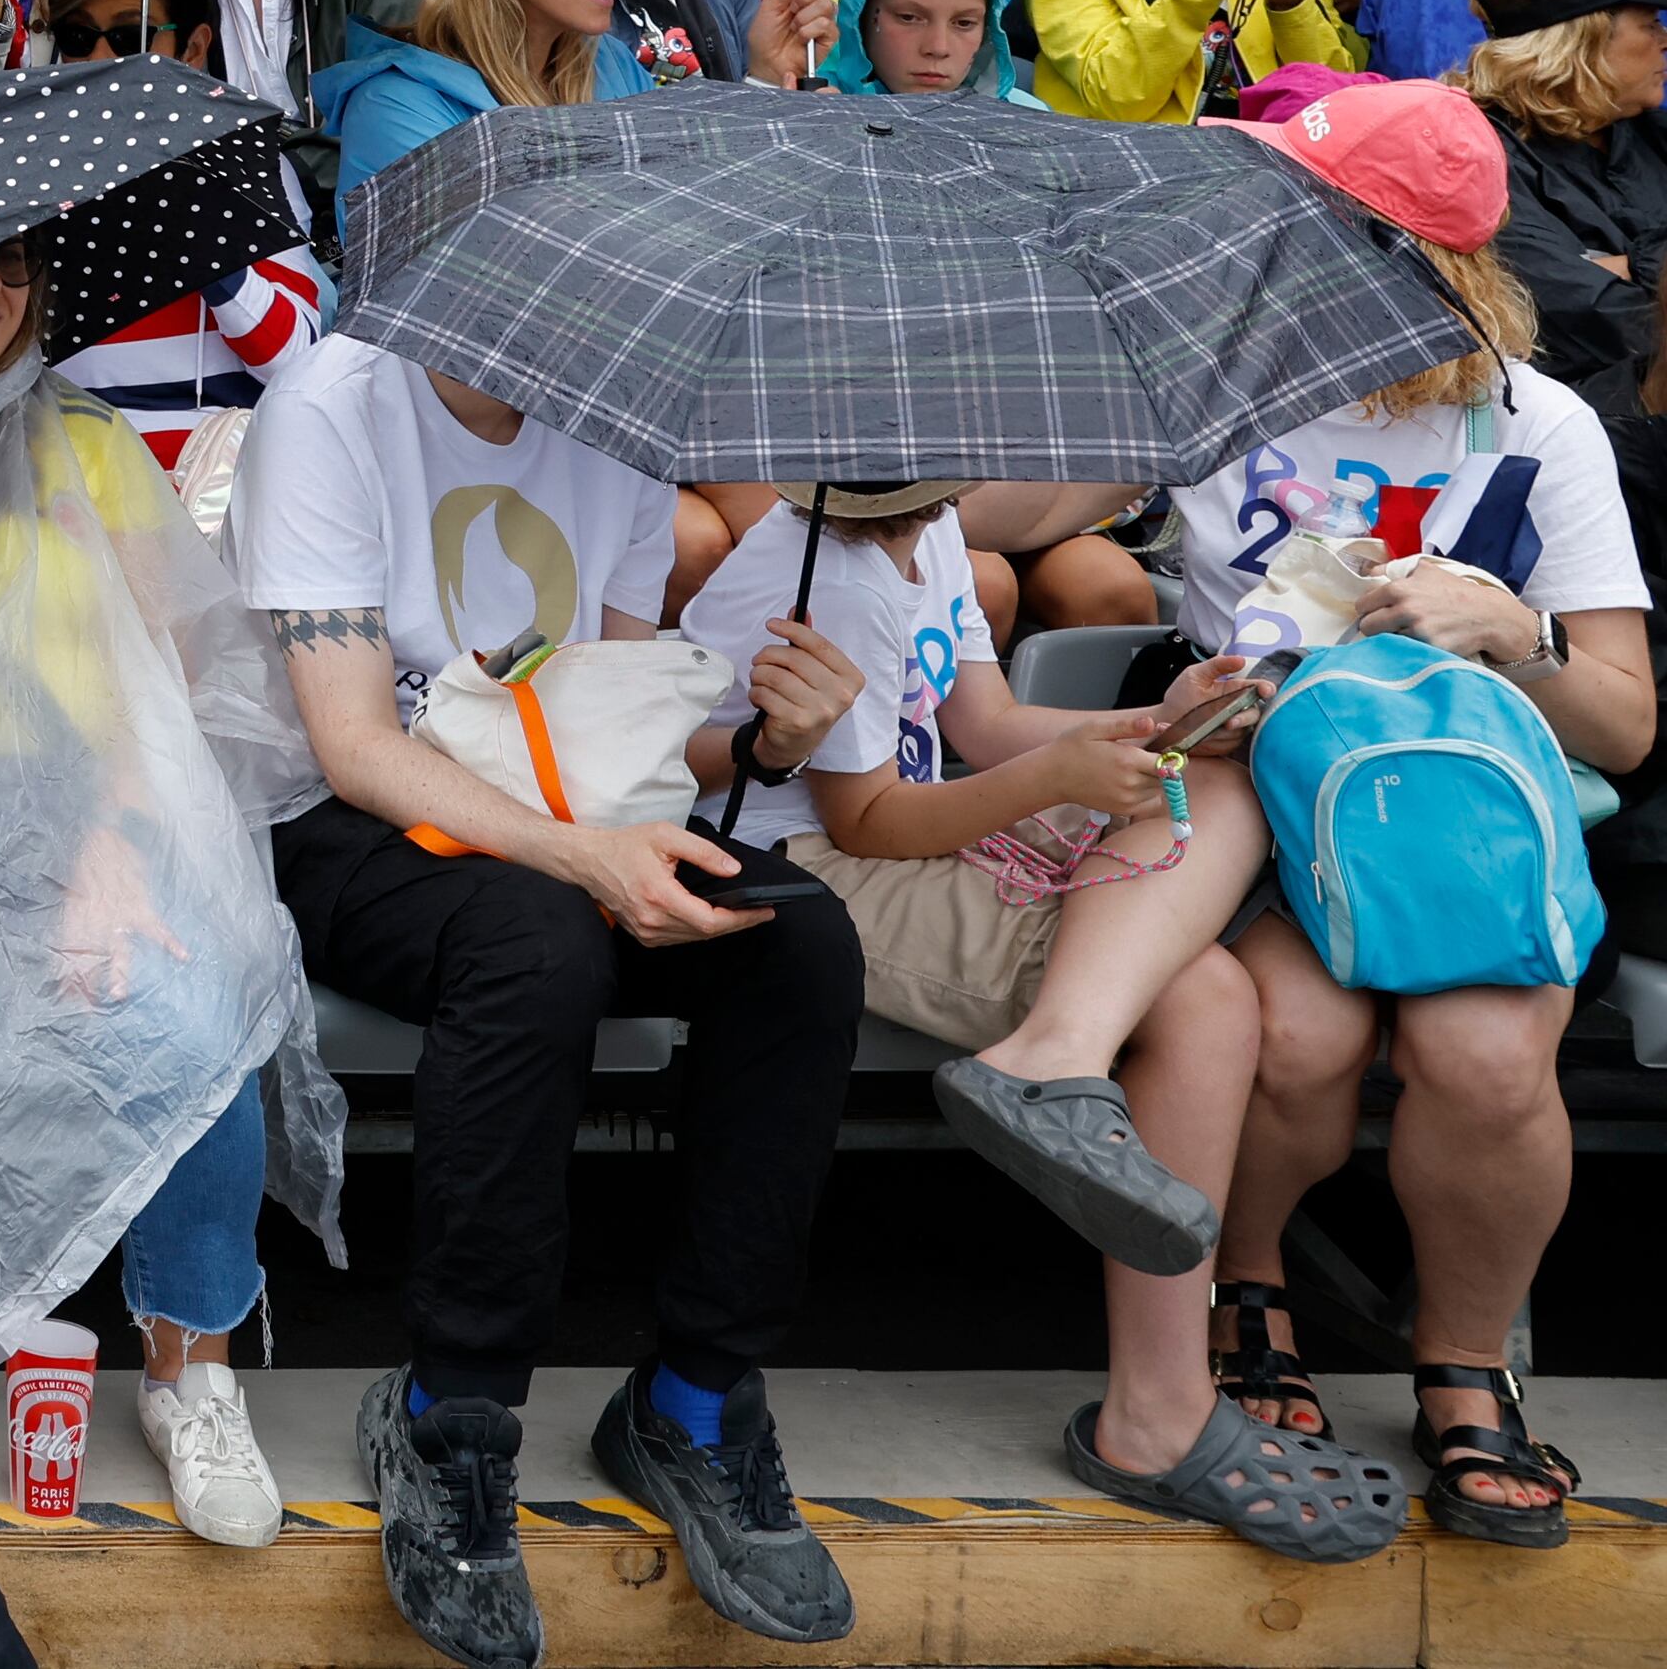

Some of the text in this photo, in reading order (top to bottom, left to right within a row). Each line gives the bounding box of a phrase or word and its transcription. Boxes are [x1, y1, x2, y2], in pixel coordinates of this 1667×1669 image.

[1301, 95, 1331, 142] das
[38, 1381, 65, 1390] GAMES
[31, 1485, 70, 1499] PARIS
